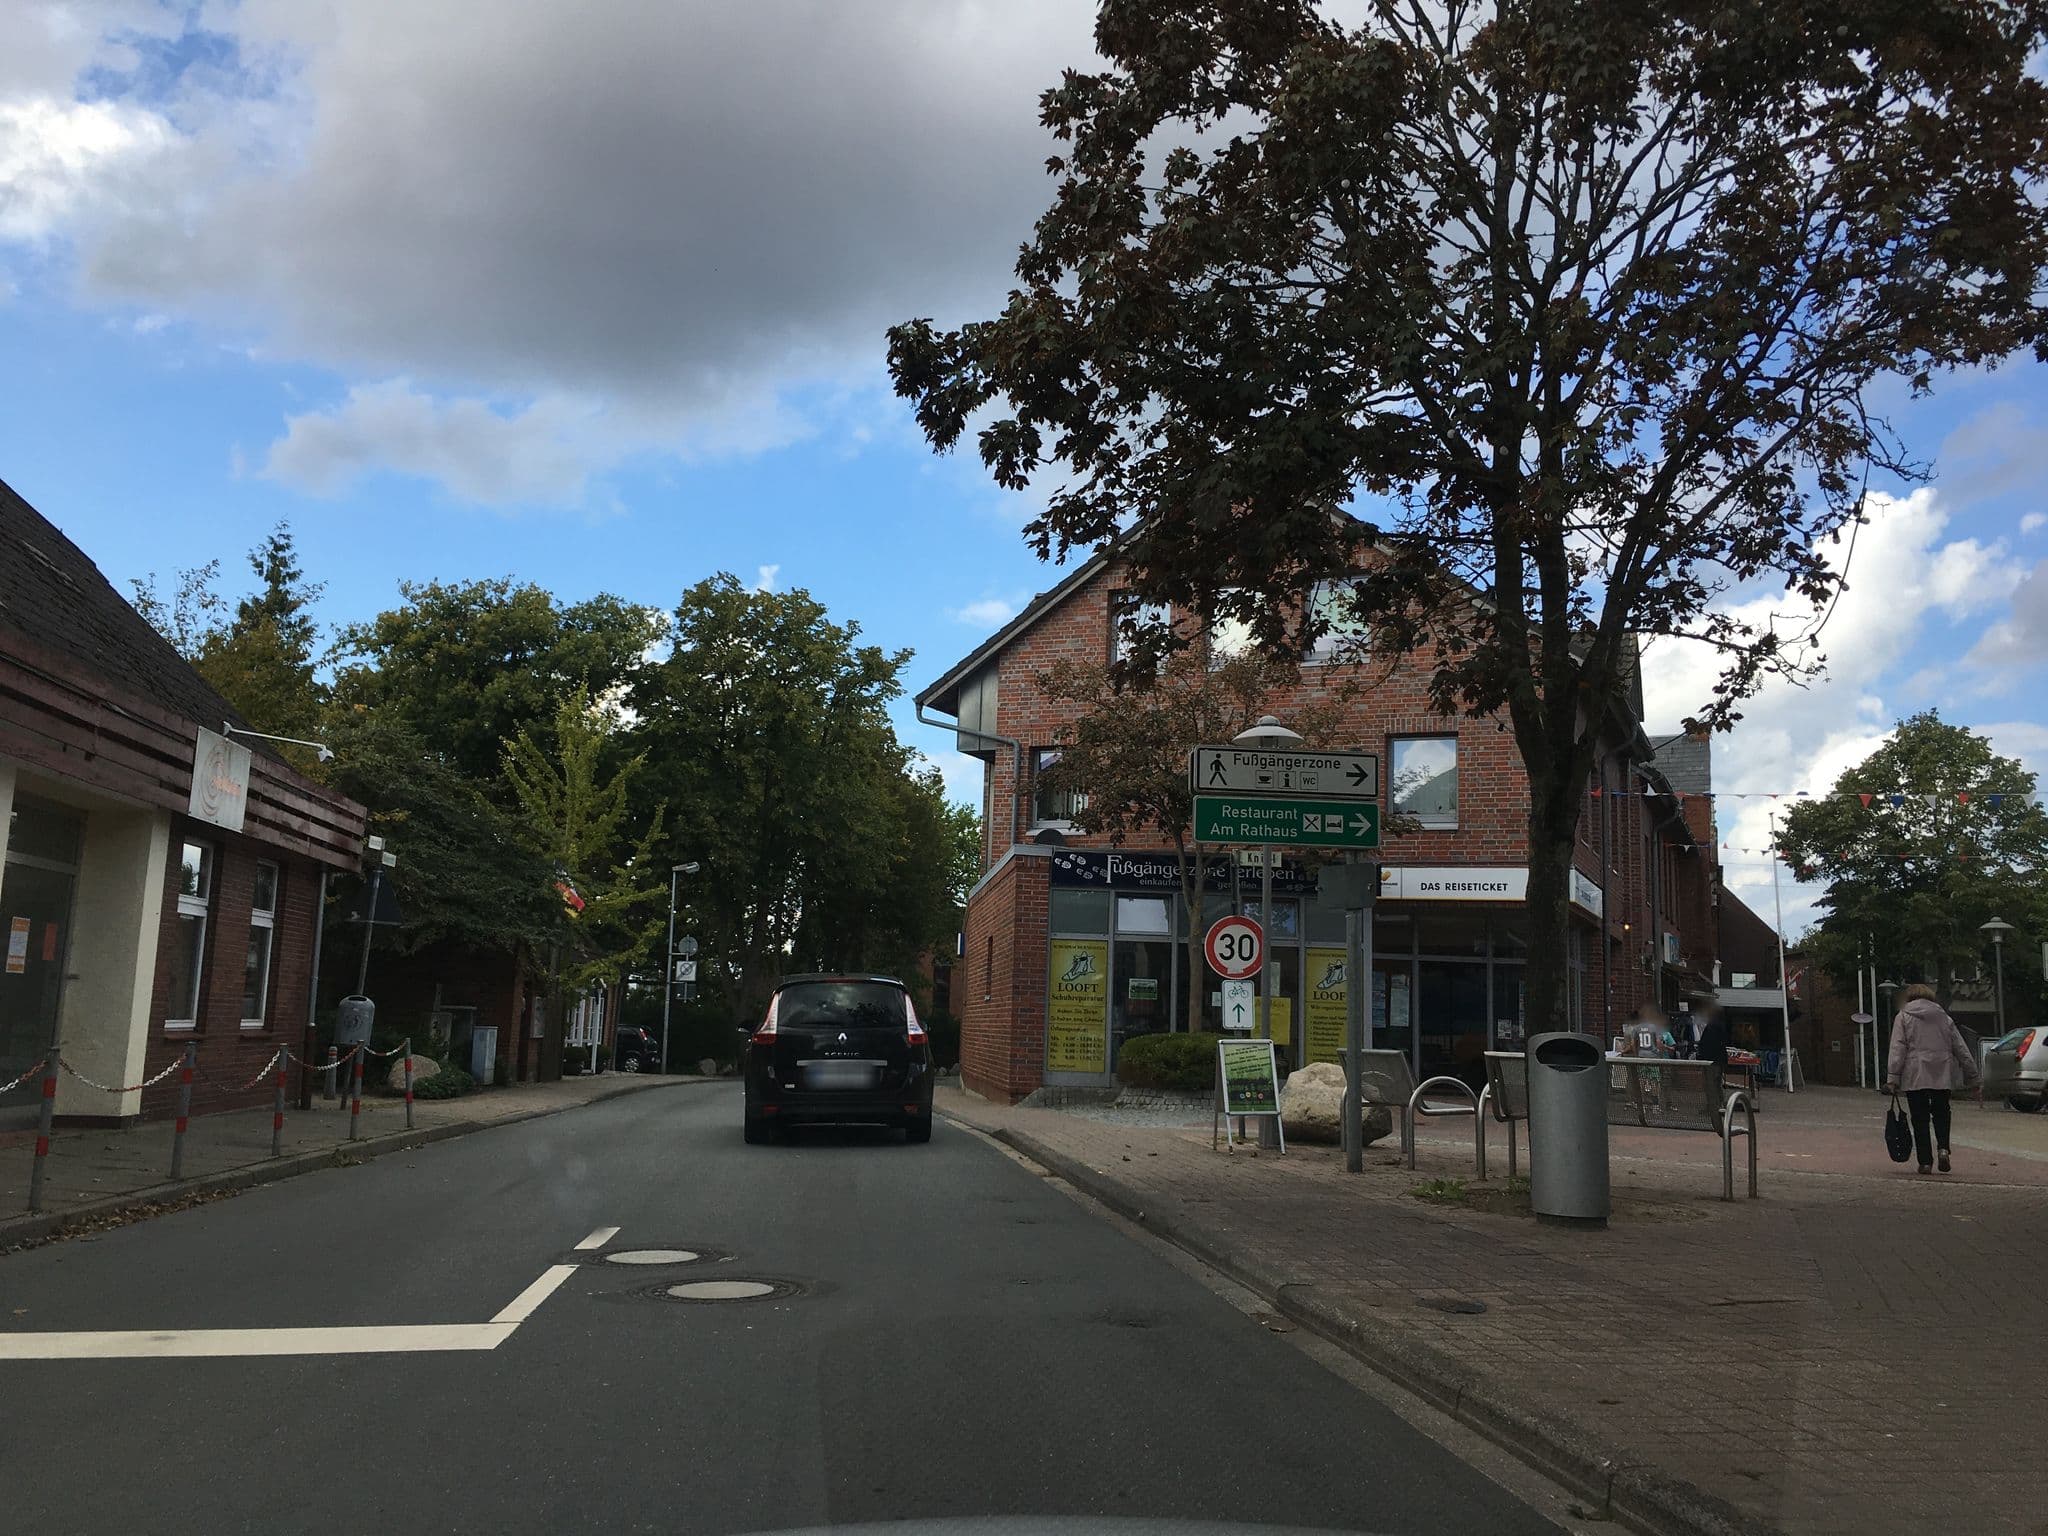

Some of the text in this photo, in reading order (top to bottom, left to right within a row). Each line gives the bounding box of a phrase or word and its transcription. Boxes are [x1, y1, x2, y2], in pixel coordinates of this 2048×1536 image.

[1233, 753, 1341, 770] Fußgängerzone
[1302, 777, 1316, 785] WC
[1222, 805, 1298, 820] Restaurant
[1210, 822, 1298, 837] Am Rathaus
[1106, 855, 1226, 883] Fußgängezne
[1420, 882, 1509, 892] DAS REISETICKET
[1219, 933, 1255, 961] 30
[1058, 983, 1099, 992] LOOFT
[1313, 991, 1347, 1001] LOOF
[1638, 1032, 1652, 1047] 10
